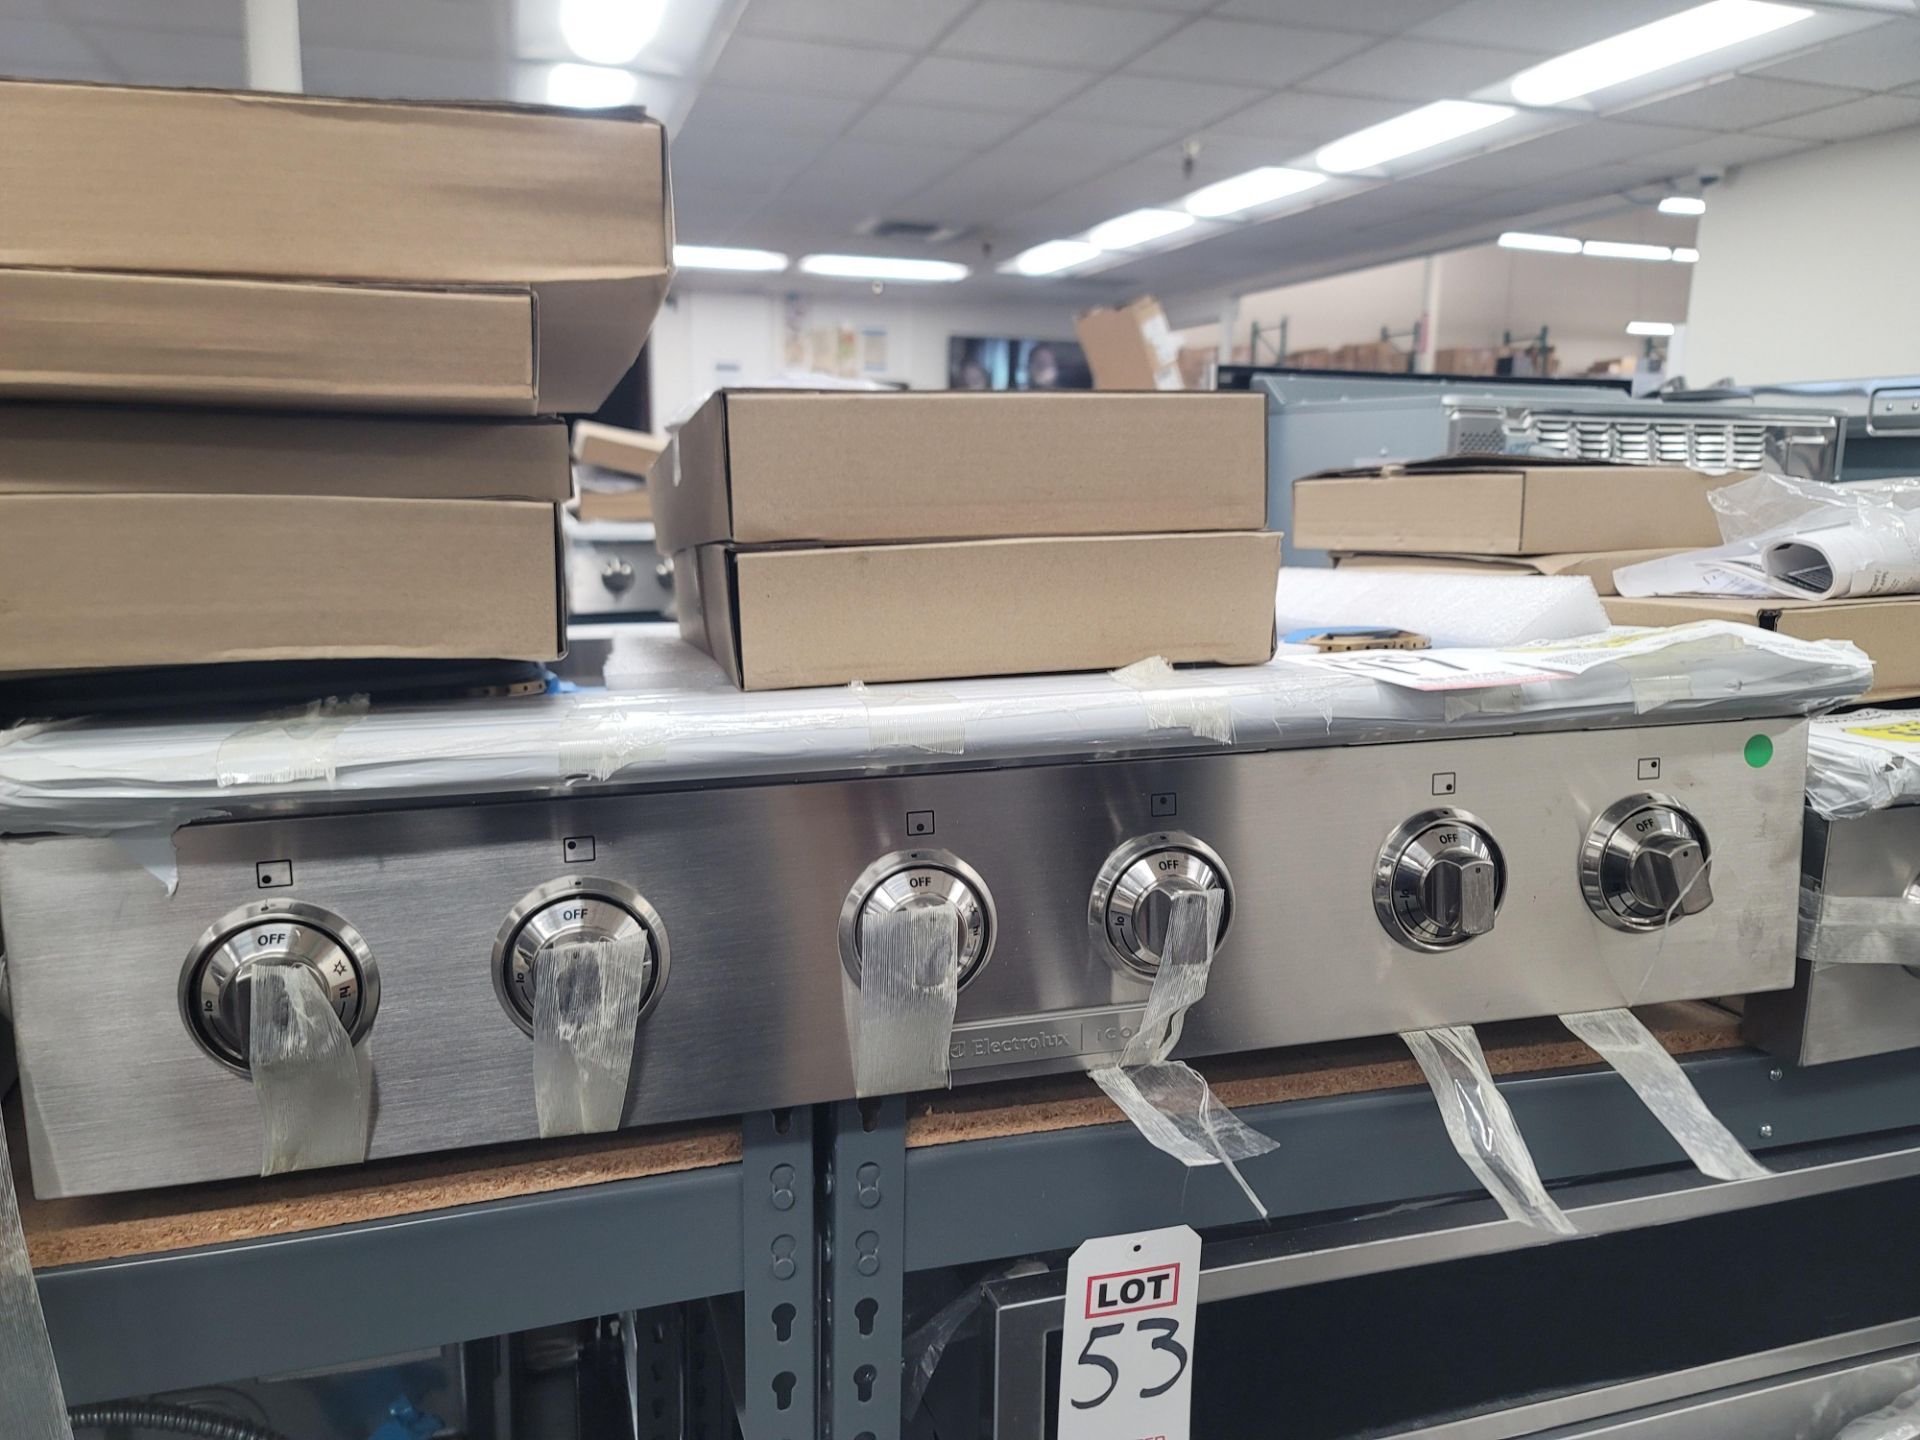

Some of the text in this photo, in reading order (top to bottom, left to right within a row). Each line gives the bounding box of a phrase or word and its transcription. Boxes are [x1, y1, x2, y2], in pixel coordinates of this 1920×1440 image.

[1635, 818, 1655, 832] OFF
[1439, 833, 1458, 845] OFF
[1158, 860, 1179, 871] OFF
[909, 877, 931, 888] OFF
[563, 909, 588, 921] OFF
[257, 933, 286, 946] OFF
[972, 1024, 1141, 1055] Electrolux ICO
[1097, 1273, 1170, 1308] LOT
[1071, 1317, 1188, 1409] 53
